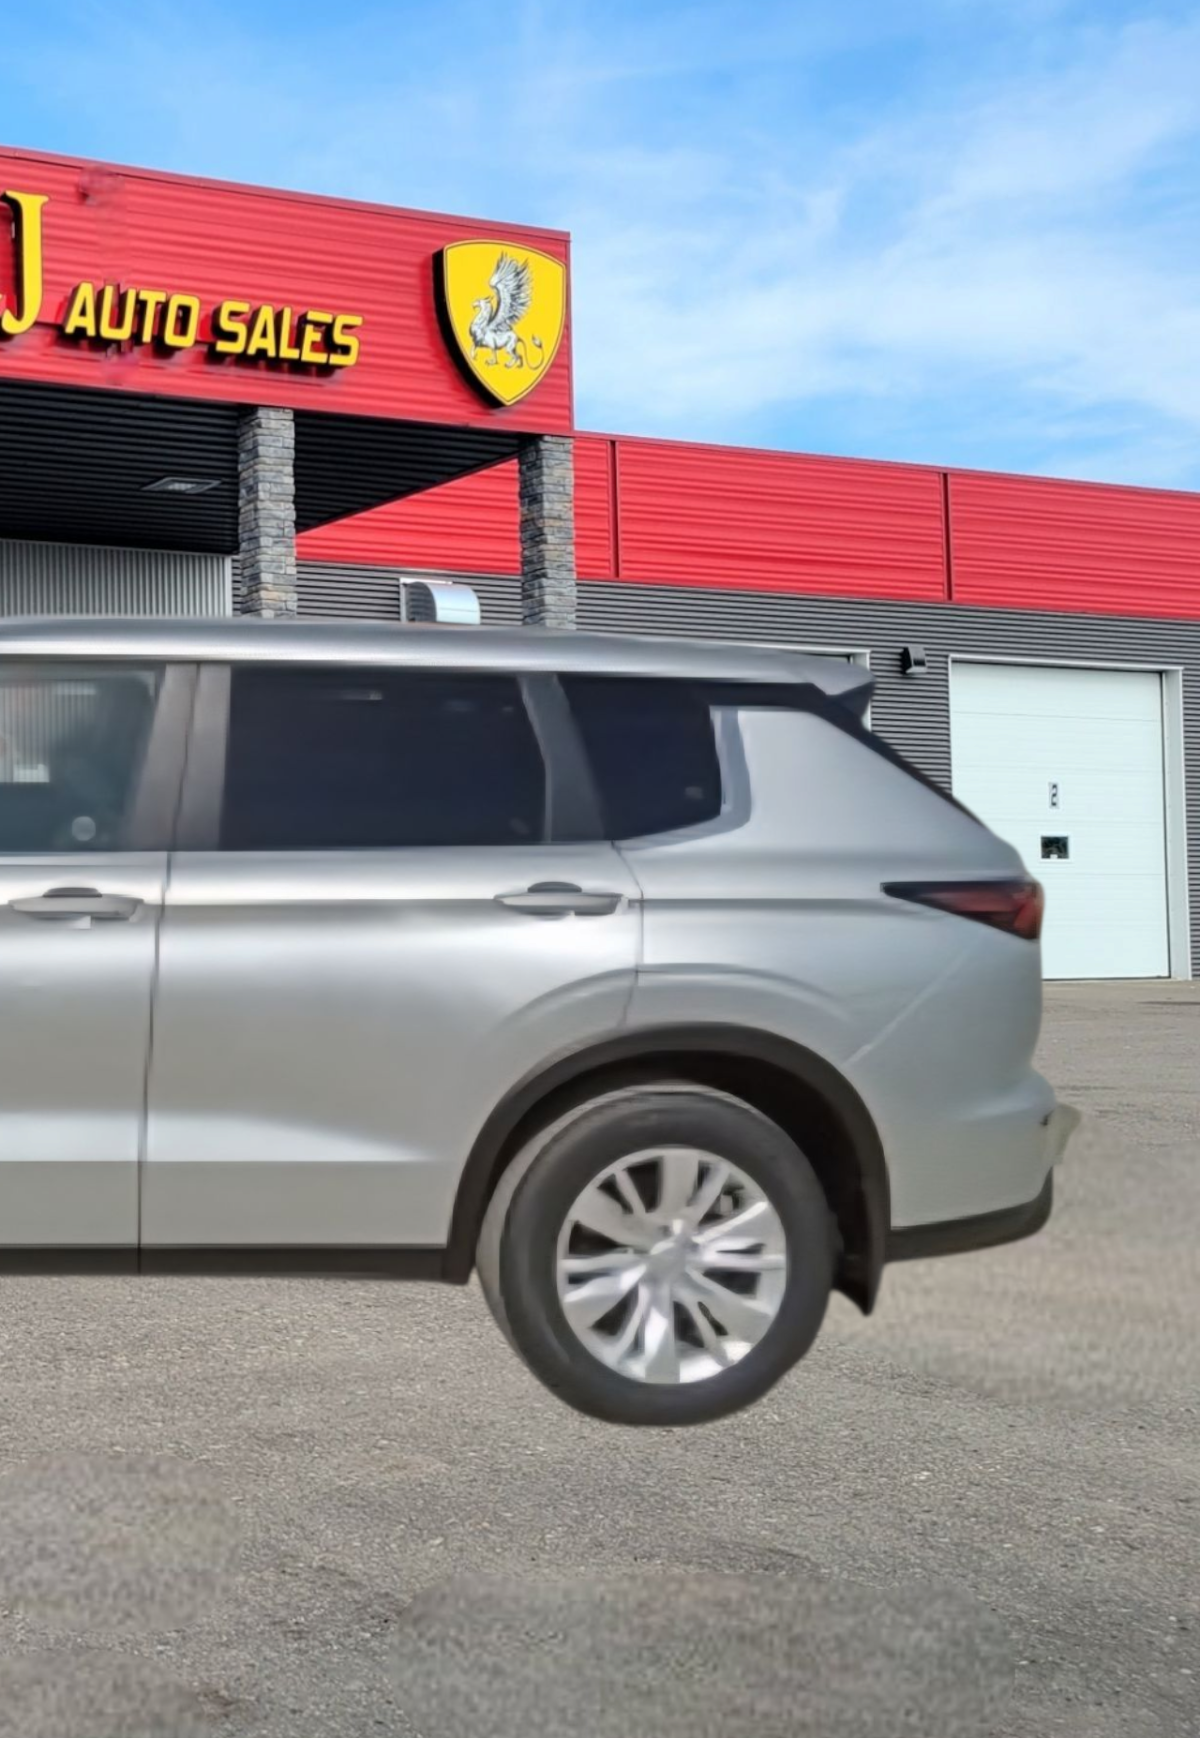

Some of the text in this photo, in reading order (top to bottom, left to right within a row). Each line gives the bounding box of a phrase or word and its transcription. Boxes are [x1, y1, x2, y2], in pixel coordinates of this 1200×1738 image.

[64, 282, 200, 348] AUTO
[215, 300, 364, 366] SALES
[1050, 783, 1058, 807] 2
